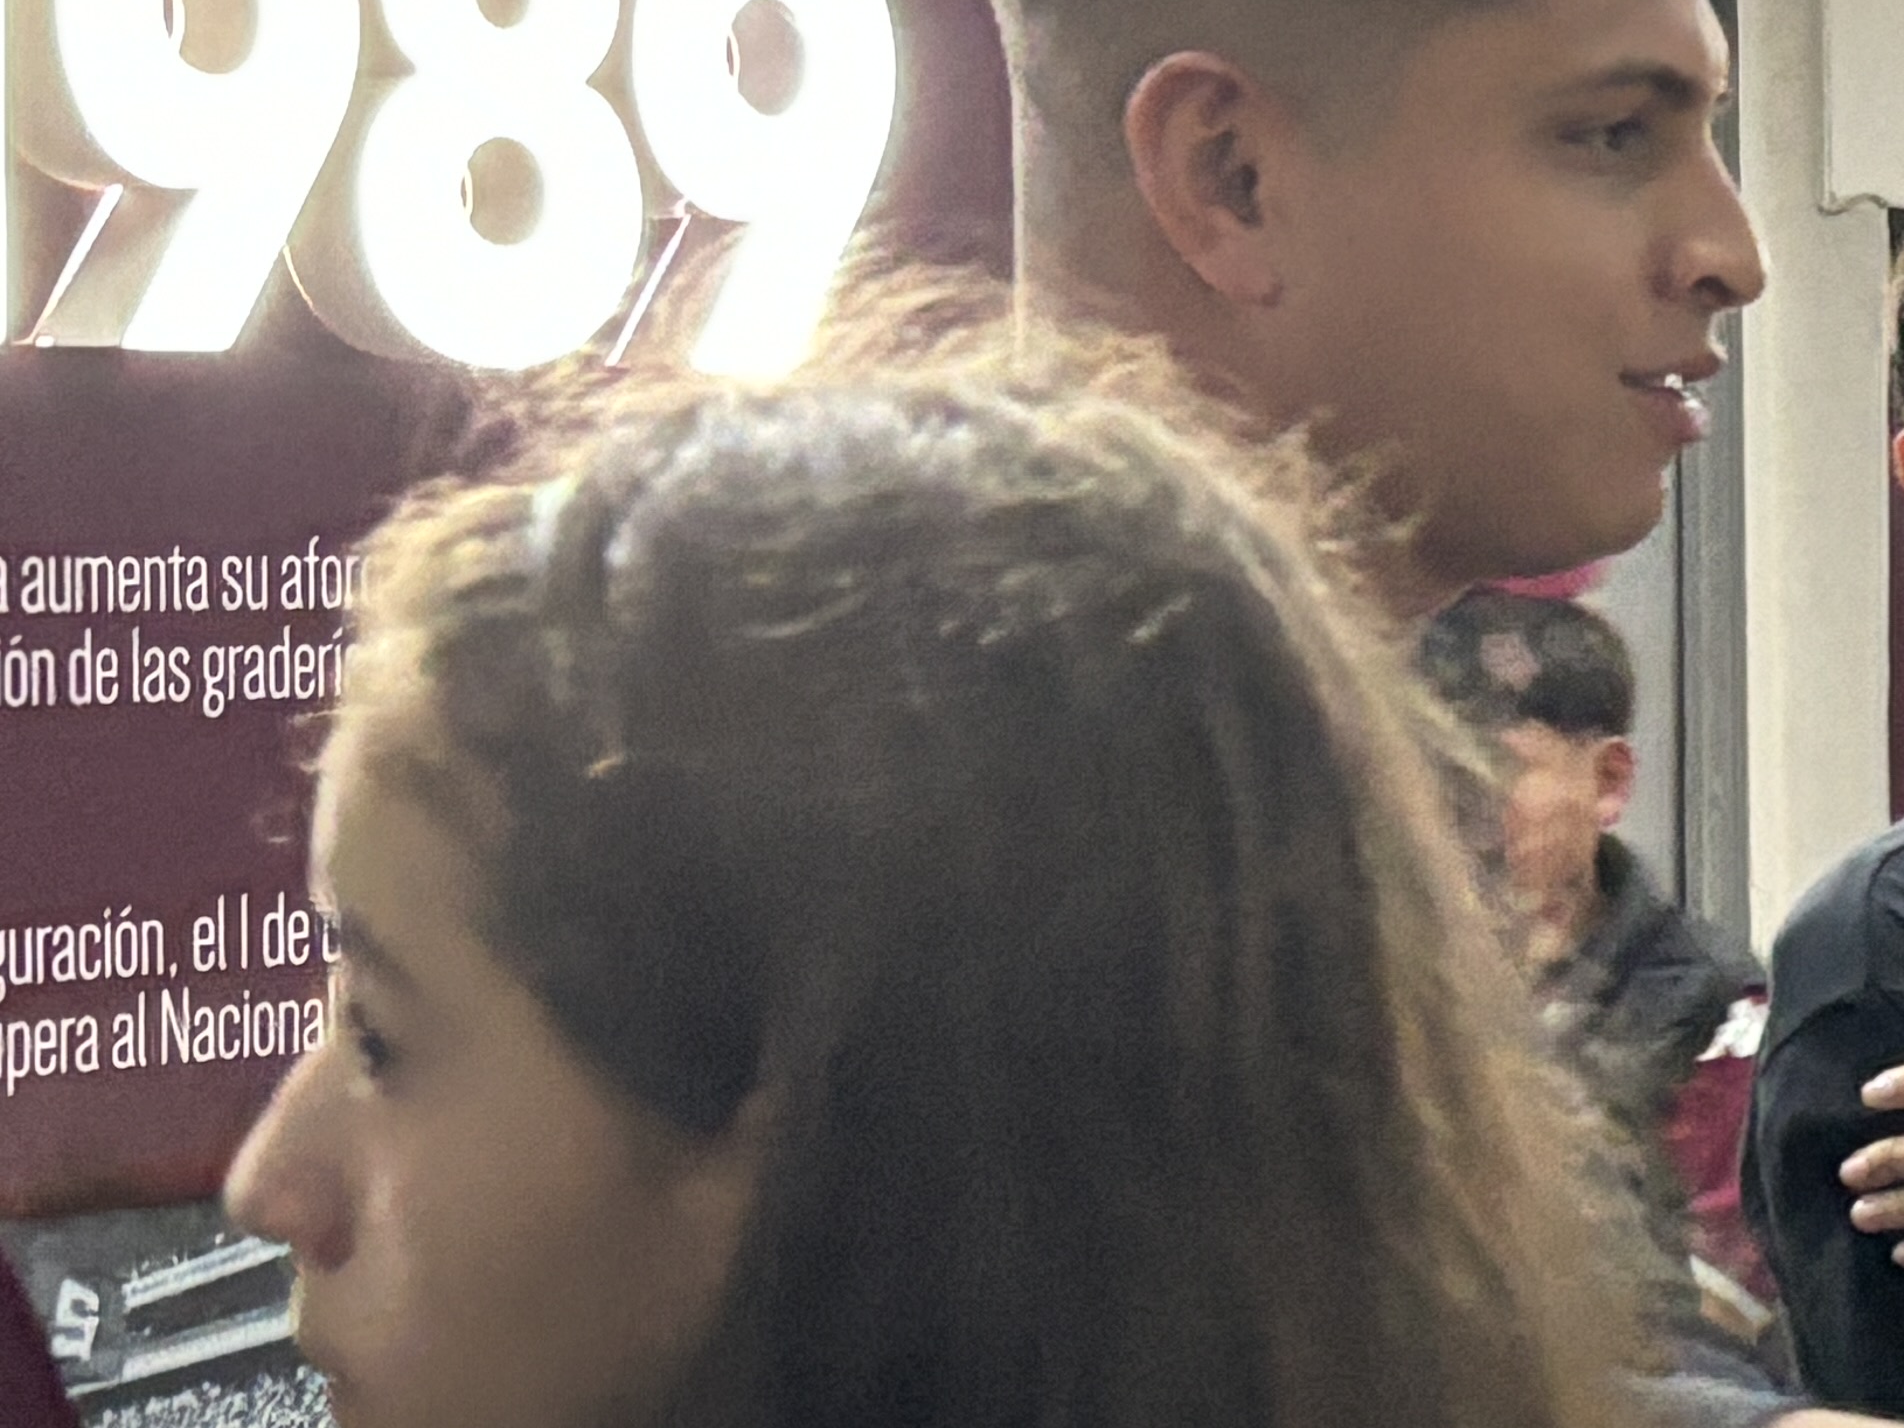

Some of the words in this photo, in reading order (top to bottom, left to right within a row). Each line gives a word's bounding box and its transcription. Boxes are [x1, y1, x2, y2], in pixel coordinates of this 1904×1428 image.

[20, 544, 210, 615] aumenta
[221, 554, 269, 613] su
[0, 633, 57, 708] ón
[68, 627, 120, 706] de
[131, 625, 192, 704] las
[0, 903, 178, 1003] uración,
[192, 893, 228, 972] el
[262, 890, 311, 969] de
[0, 1015, 100, 1098] pera
[111, 989, 148, 1071] al
[160, 971, 337, 1066] Nacional
